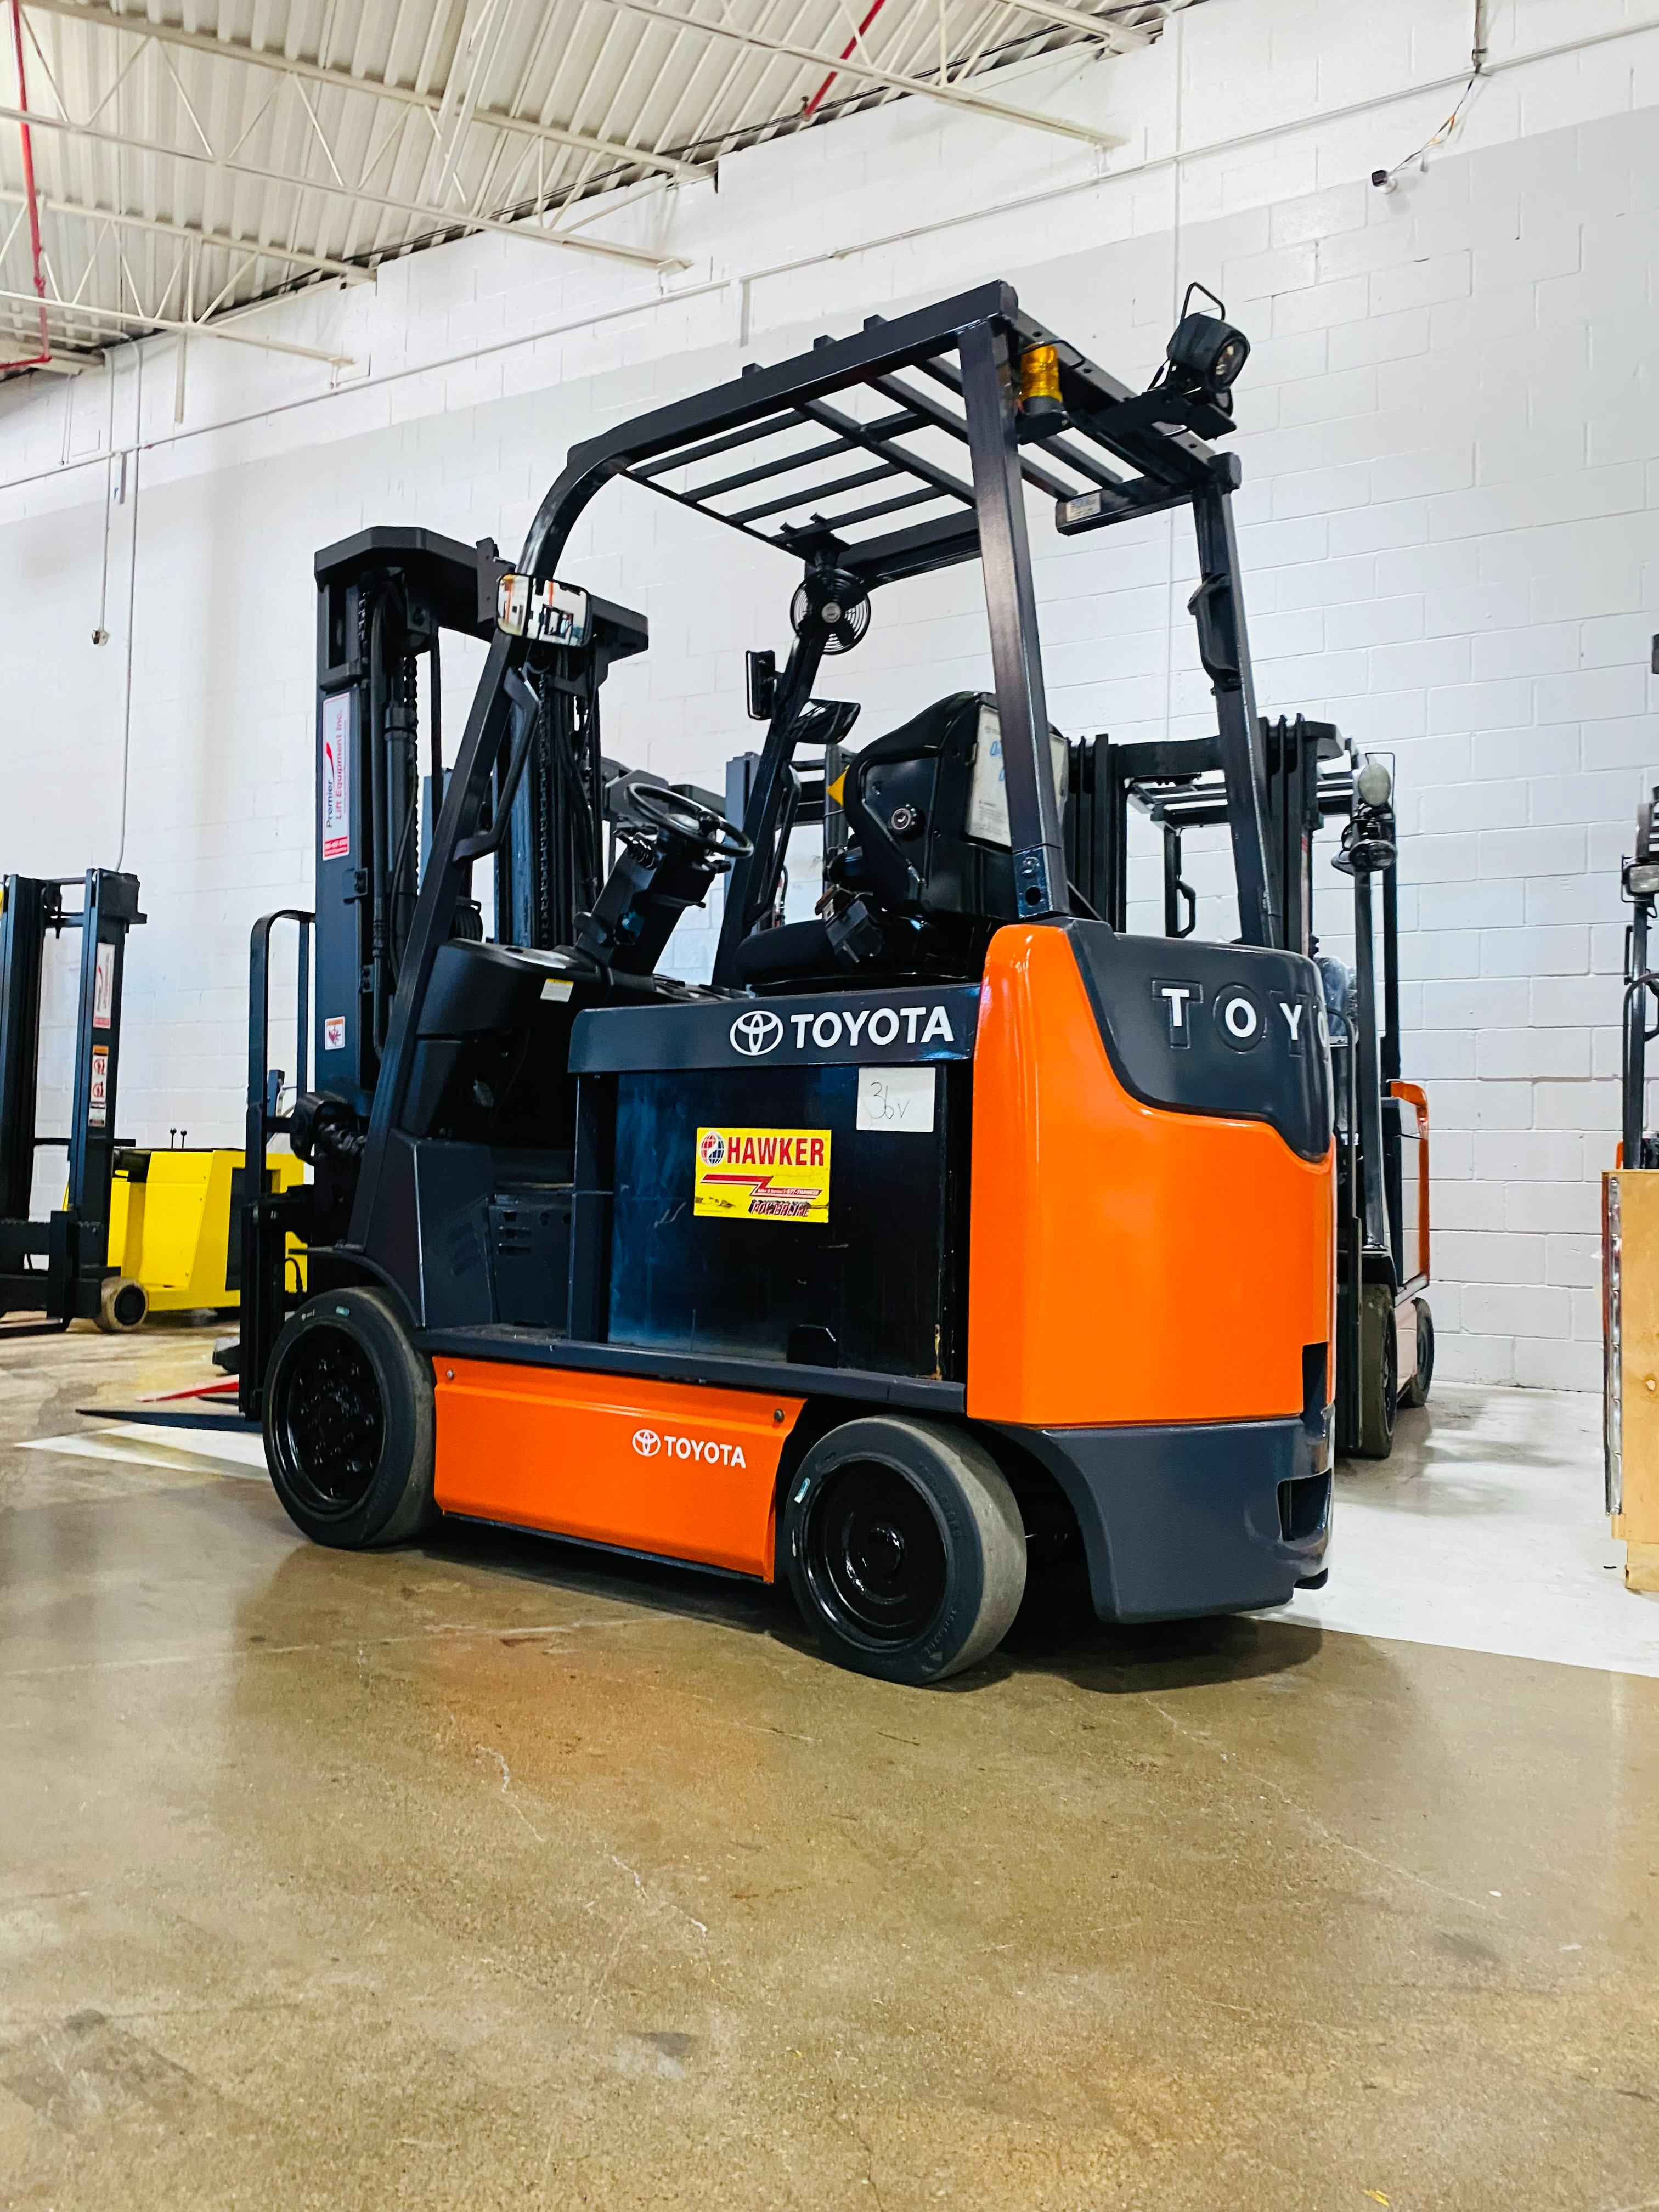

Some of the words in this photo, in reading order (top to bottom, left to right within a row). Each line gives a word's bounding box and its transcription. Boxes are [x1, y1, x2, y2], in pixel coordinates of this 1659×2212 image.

[791, 1006, 954, 1048] TOYOTA
[727, 1137, 825, 1166] HAWKER
[749, 1200, 810, 1217] POWERLINE
[663, 1435, 746, 1468] TOYOTA
